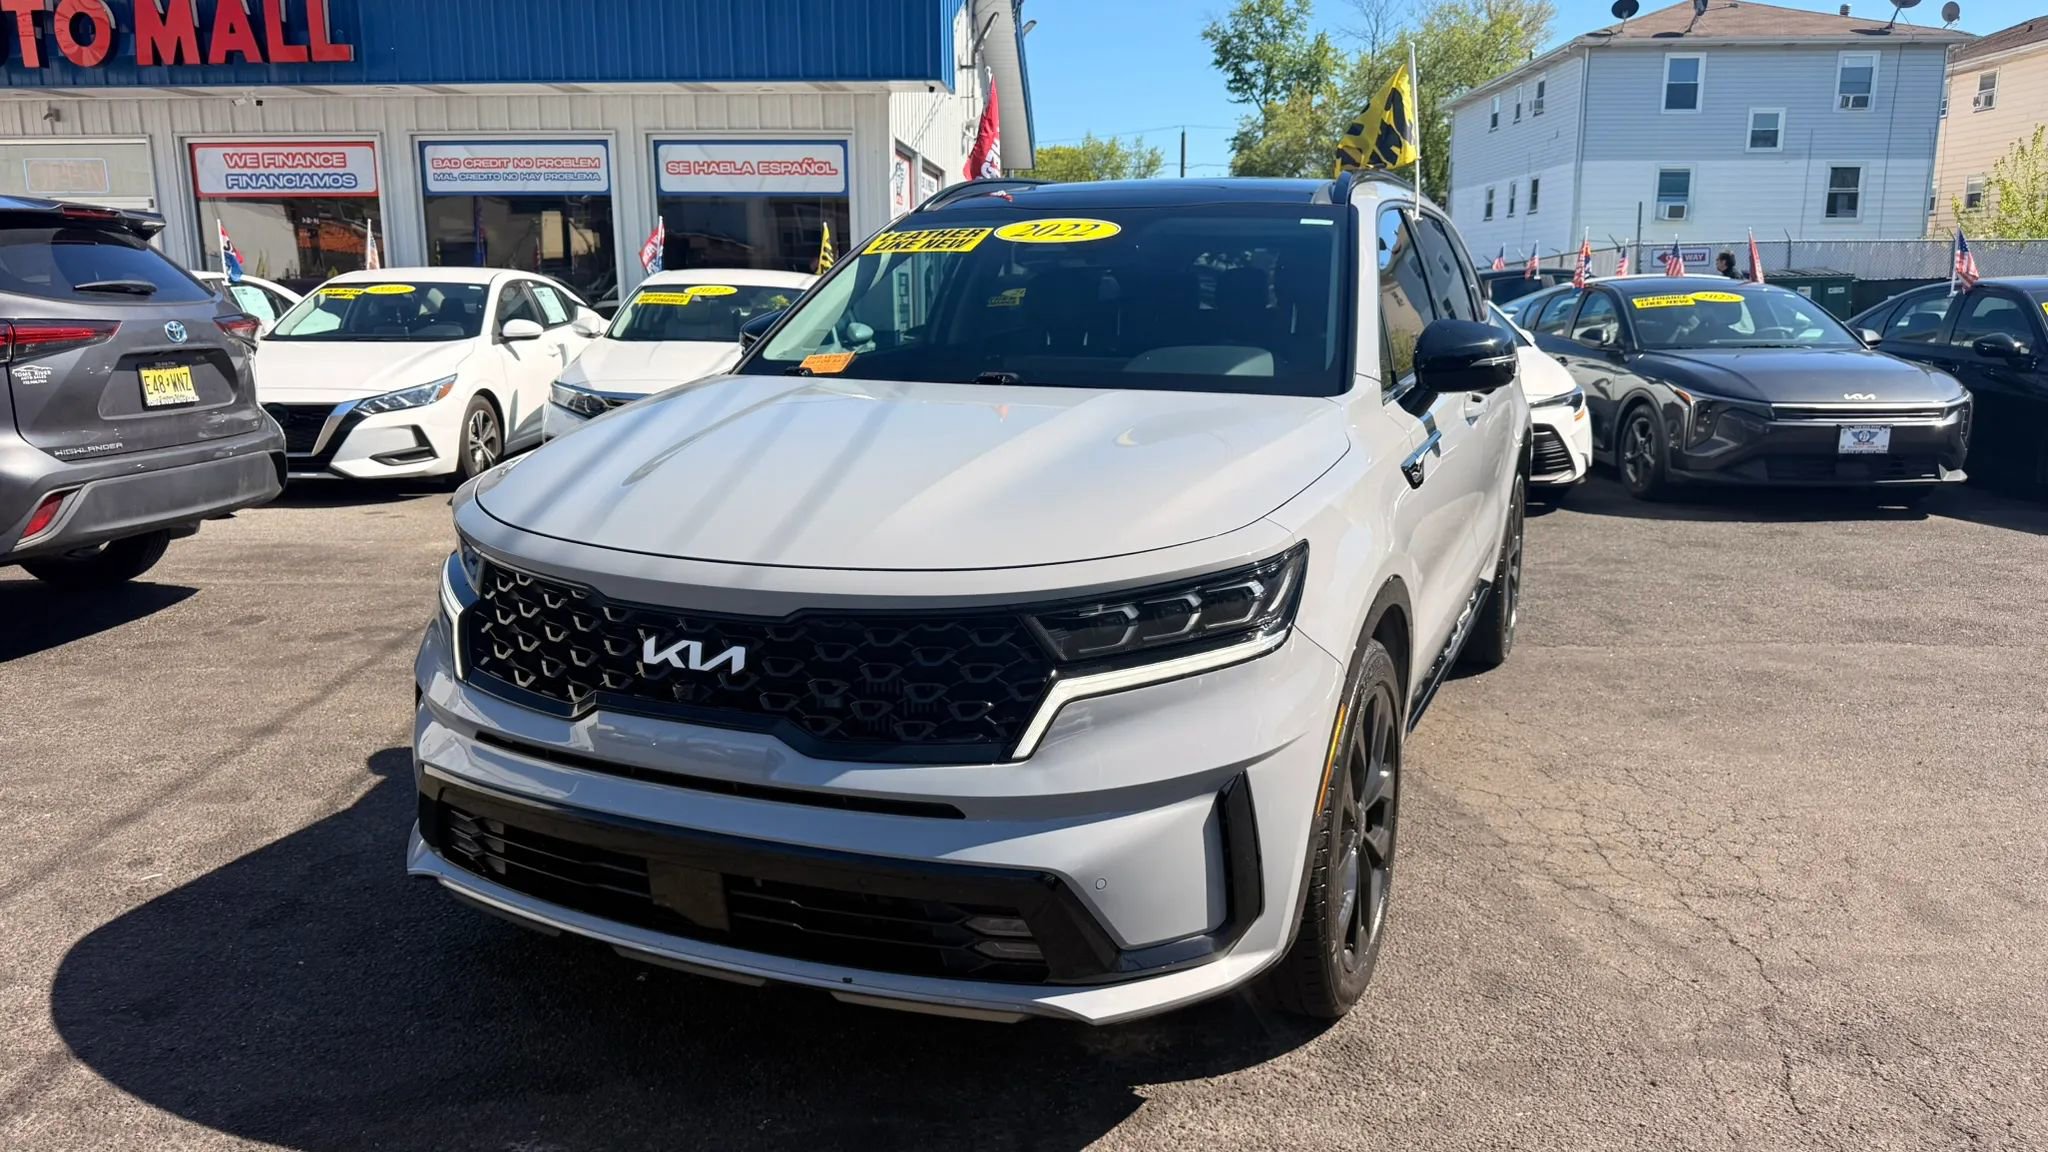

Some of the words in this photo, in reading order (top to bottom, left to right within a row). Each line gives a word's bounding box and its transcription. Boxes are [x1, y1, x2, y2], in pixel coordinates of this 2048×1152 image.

[135, 0, 354, 66] MALL
[224, 152, 259, 168] WE
[262, 151, 347, 168] FINANCE
[432, 158, 461, 169] BAD
[463, 157, 511, 168] CREDIT
[513, 157, 534, 168] NO
[536, 157, 601, 169] PROBLEM
[666, 161, 690, 175] SE
[693, 161, 754, 175] HABLA
[757, 157, 838, 176] ESPAÑOL
[225, 173, 357, 189] FINANCIAMOS
[433, 173, 457, 181] MAL
[458, 173, 501, 181] CREDITO
[502, 173, 519, 181] NO
[520, 173, 542, 181] HAY
[544, 173, 601, 181] PROBLEMA
[879, 228, 987, 242] LEATHER
[1010, 223, 1101, 237] 2022
[871, 239, 918, 249] LIKE
[918, 238, 973, 249] NEW
[144, 374, 166, 394] E48
[54, 442, 123, 456] HIGHLANDER
[643, 636, 746, 675] KIA
